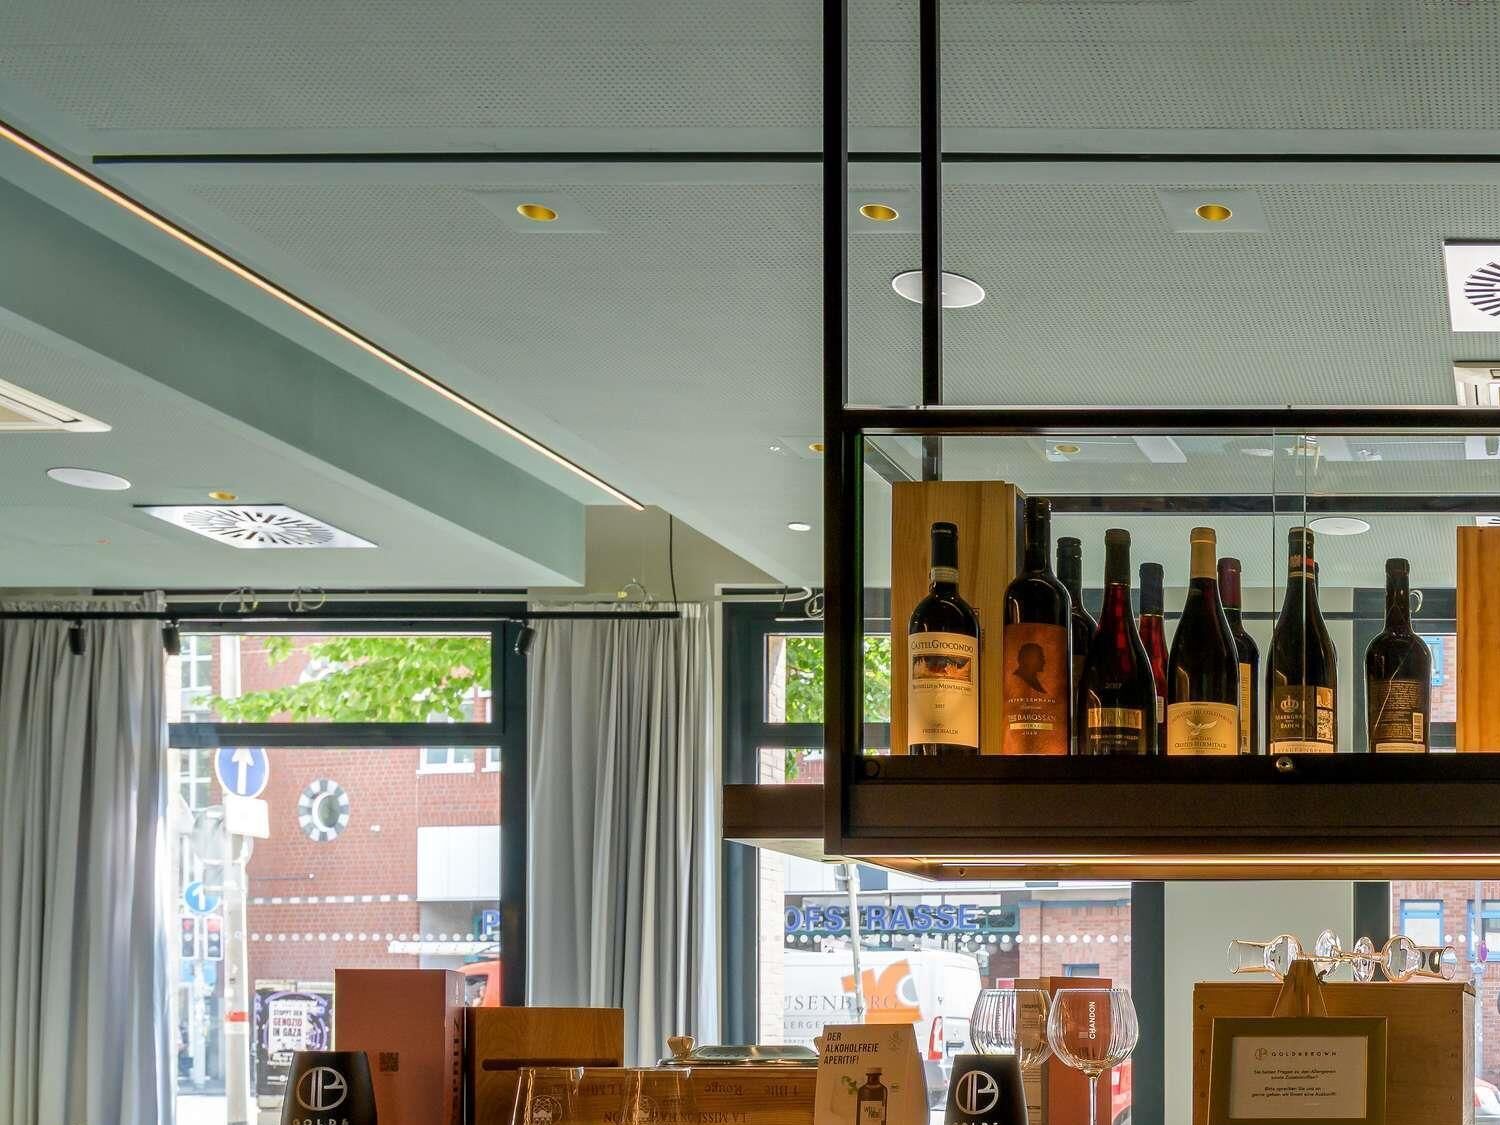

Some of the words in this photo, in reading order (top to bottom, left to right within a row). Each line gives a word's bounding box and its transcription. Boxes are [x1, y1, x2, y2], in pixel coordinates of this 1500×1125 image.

[784, 904, 978, 932] OFSRASSE
[273, 1018, 303, 1026] GENOZID
[1088, 1001, 1096, 1040] CHANDON
[283, 1027, 302, 1037] GAZA
[827, 1032, 842, 1041] DER
[825, 1043, 879, 1053] ALKOHOLFREIE
[824, 1056, 859, 1065] APERITIF!
